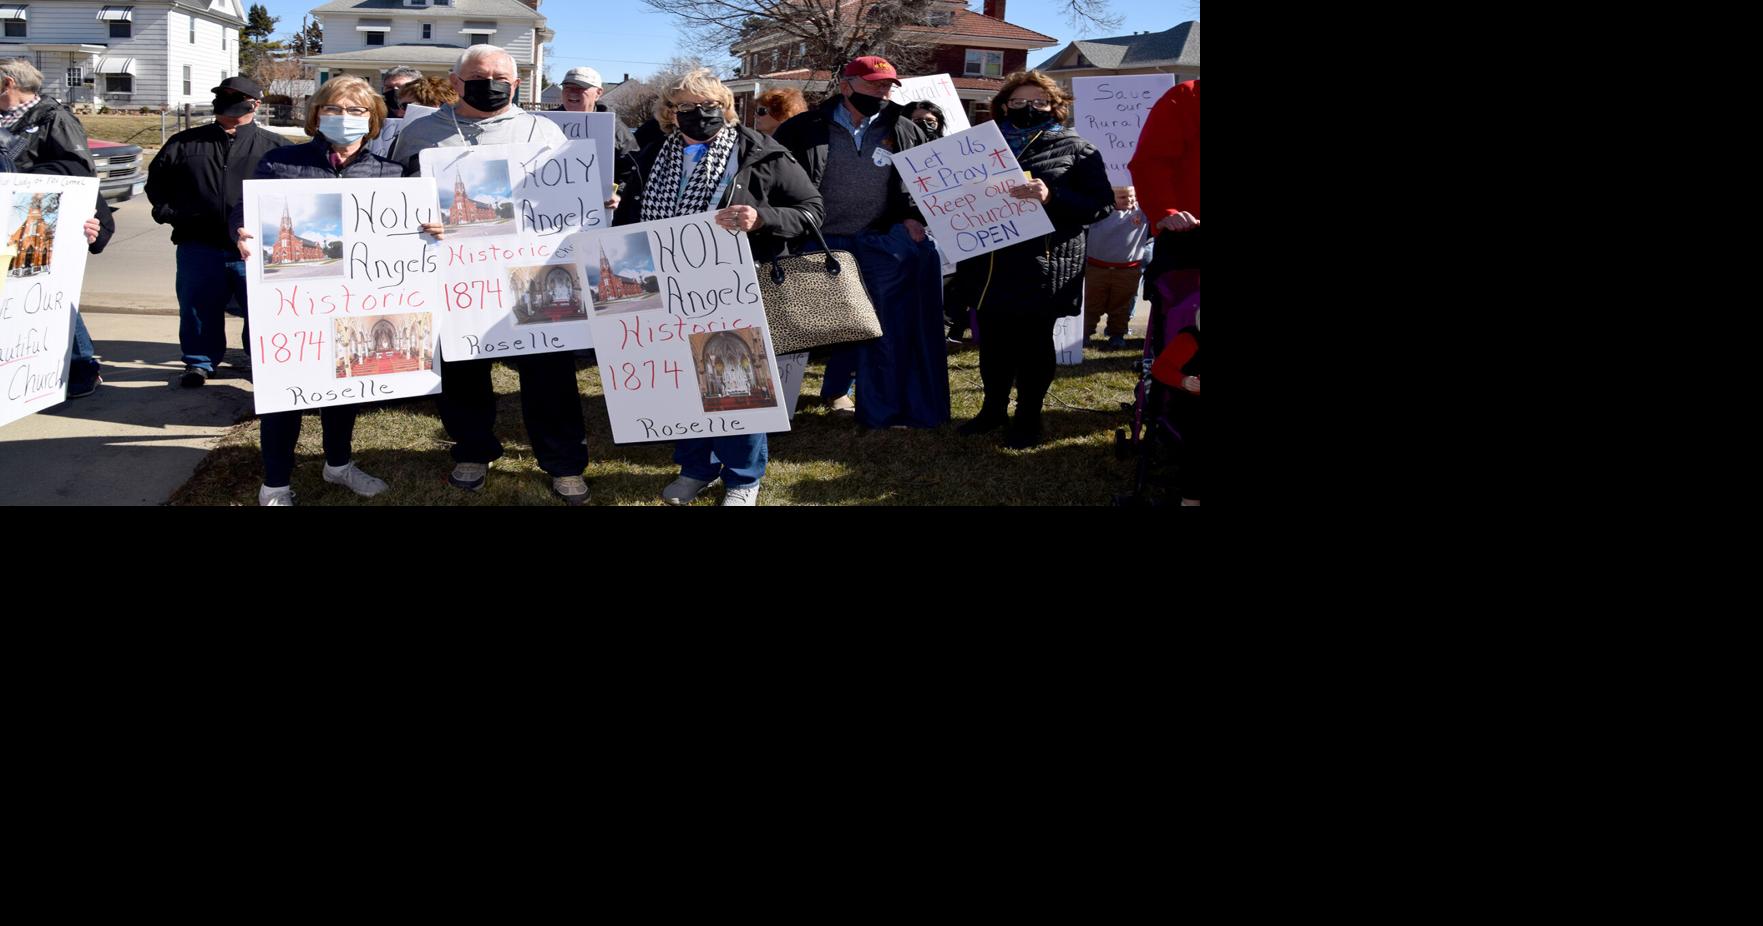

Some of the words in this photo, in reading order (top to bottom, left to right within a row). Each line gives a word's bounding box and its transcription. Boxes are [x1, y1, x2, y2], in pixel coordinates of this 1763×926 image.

[562, 115, 589, 138] ral
[1084, 114, 1141, 129] Rural
[905, 147, 944, 173] Let
[957, 135, 986, 156] Us
[1105, 132, 1136, 149] Par
[520, 154, 595, 188] HOLY
[938, 163, 989, 187] Pray
[351, 191, 431, 236] Holy
[520, 197, 601, 236] Angels
[922, 193, 977, 217] Keep
[950, 198, 1038, 231] Churches
[654, 220, 744, 273] HOLY
[956, 220, 1020, 252] OPEN
[351, 242, 437, 289] Angels
[448, 242, 550, 266] Historic
[275, 285, 425, 316] Historic
[444, 278, 503, 312] 1874
[667, 270, 760, 319] Angels
[260, 330, 326, 364] 1874
[462, 331, 565, 355] Roselle
[608, 360, 683, 391] 1874
[286, 380, 394, 406] Roselle
[637, 417, 745, 439] Roselle
